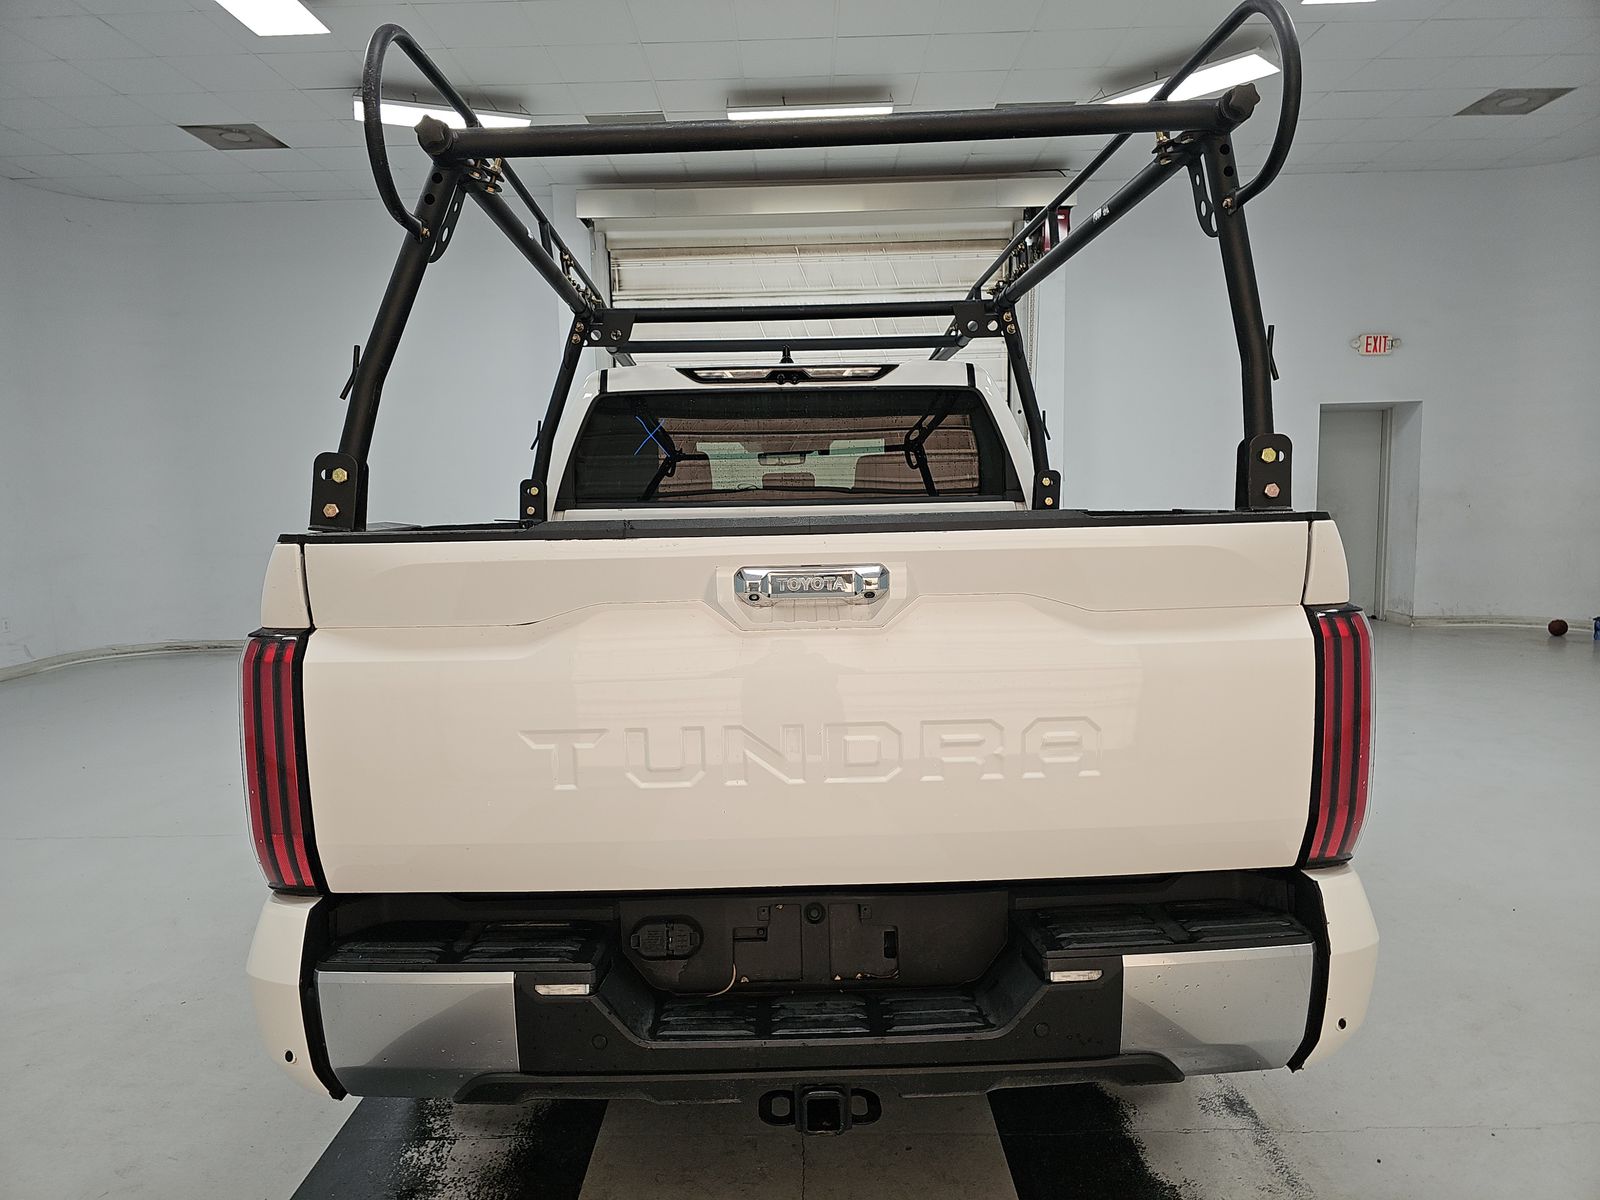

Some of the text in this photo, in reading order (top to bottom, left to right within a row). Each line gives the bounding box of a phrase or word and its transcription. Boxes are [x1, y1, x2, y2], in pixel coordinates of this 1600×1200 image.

[1365, 335, 1388, 353] EXIT
[777, 576, 848, 591] TOYOTA
[517, 716, 1102, 790] TUNDRA
